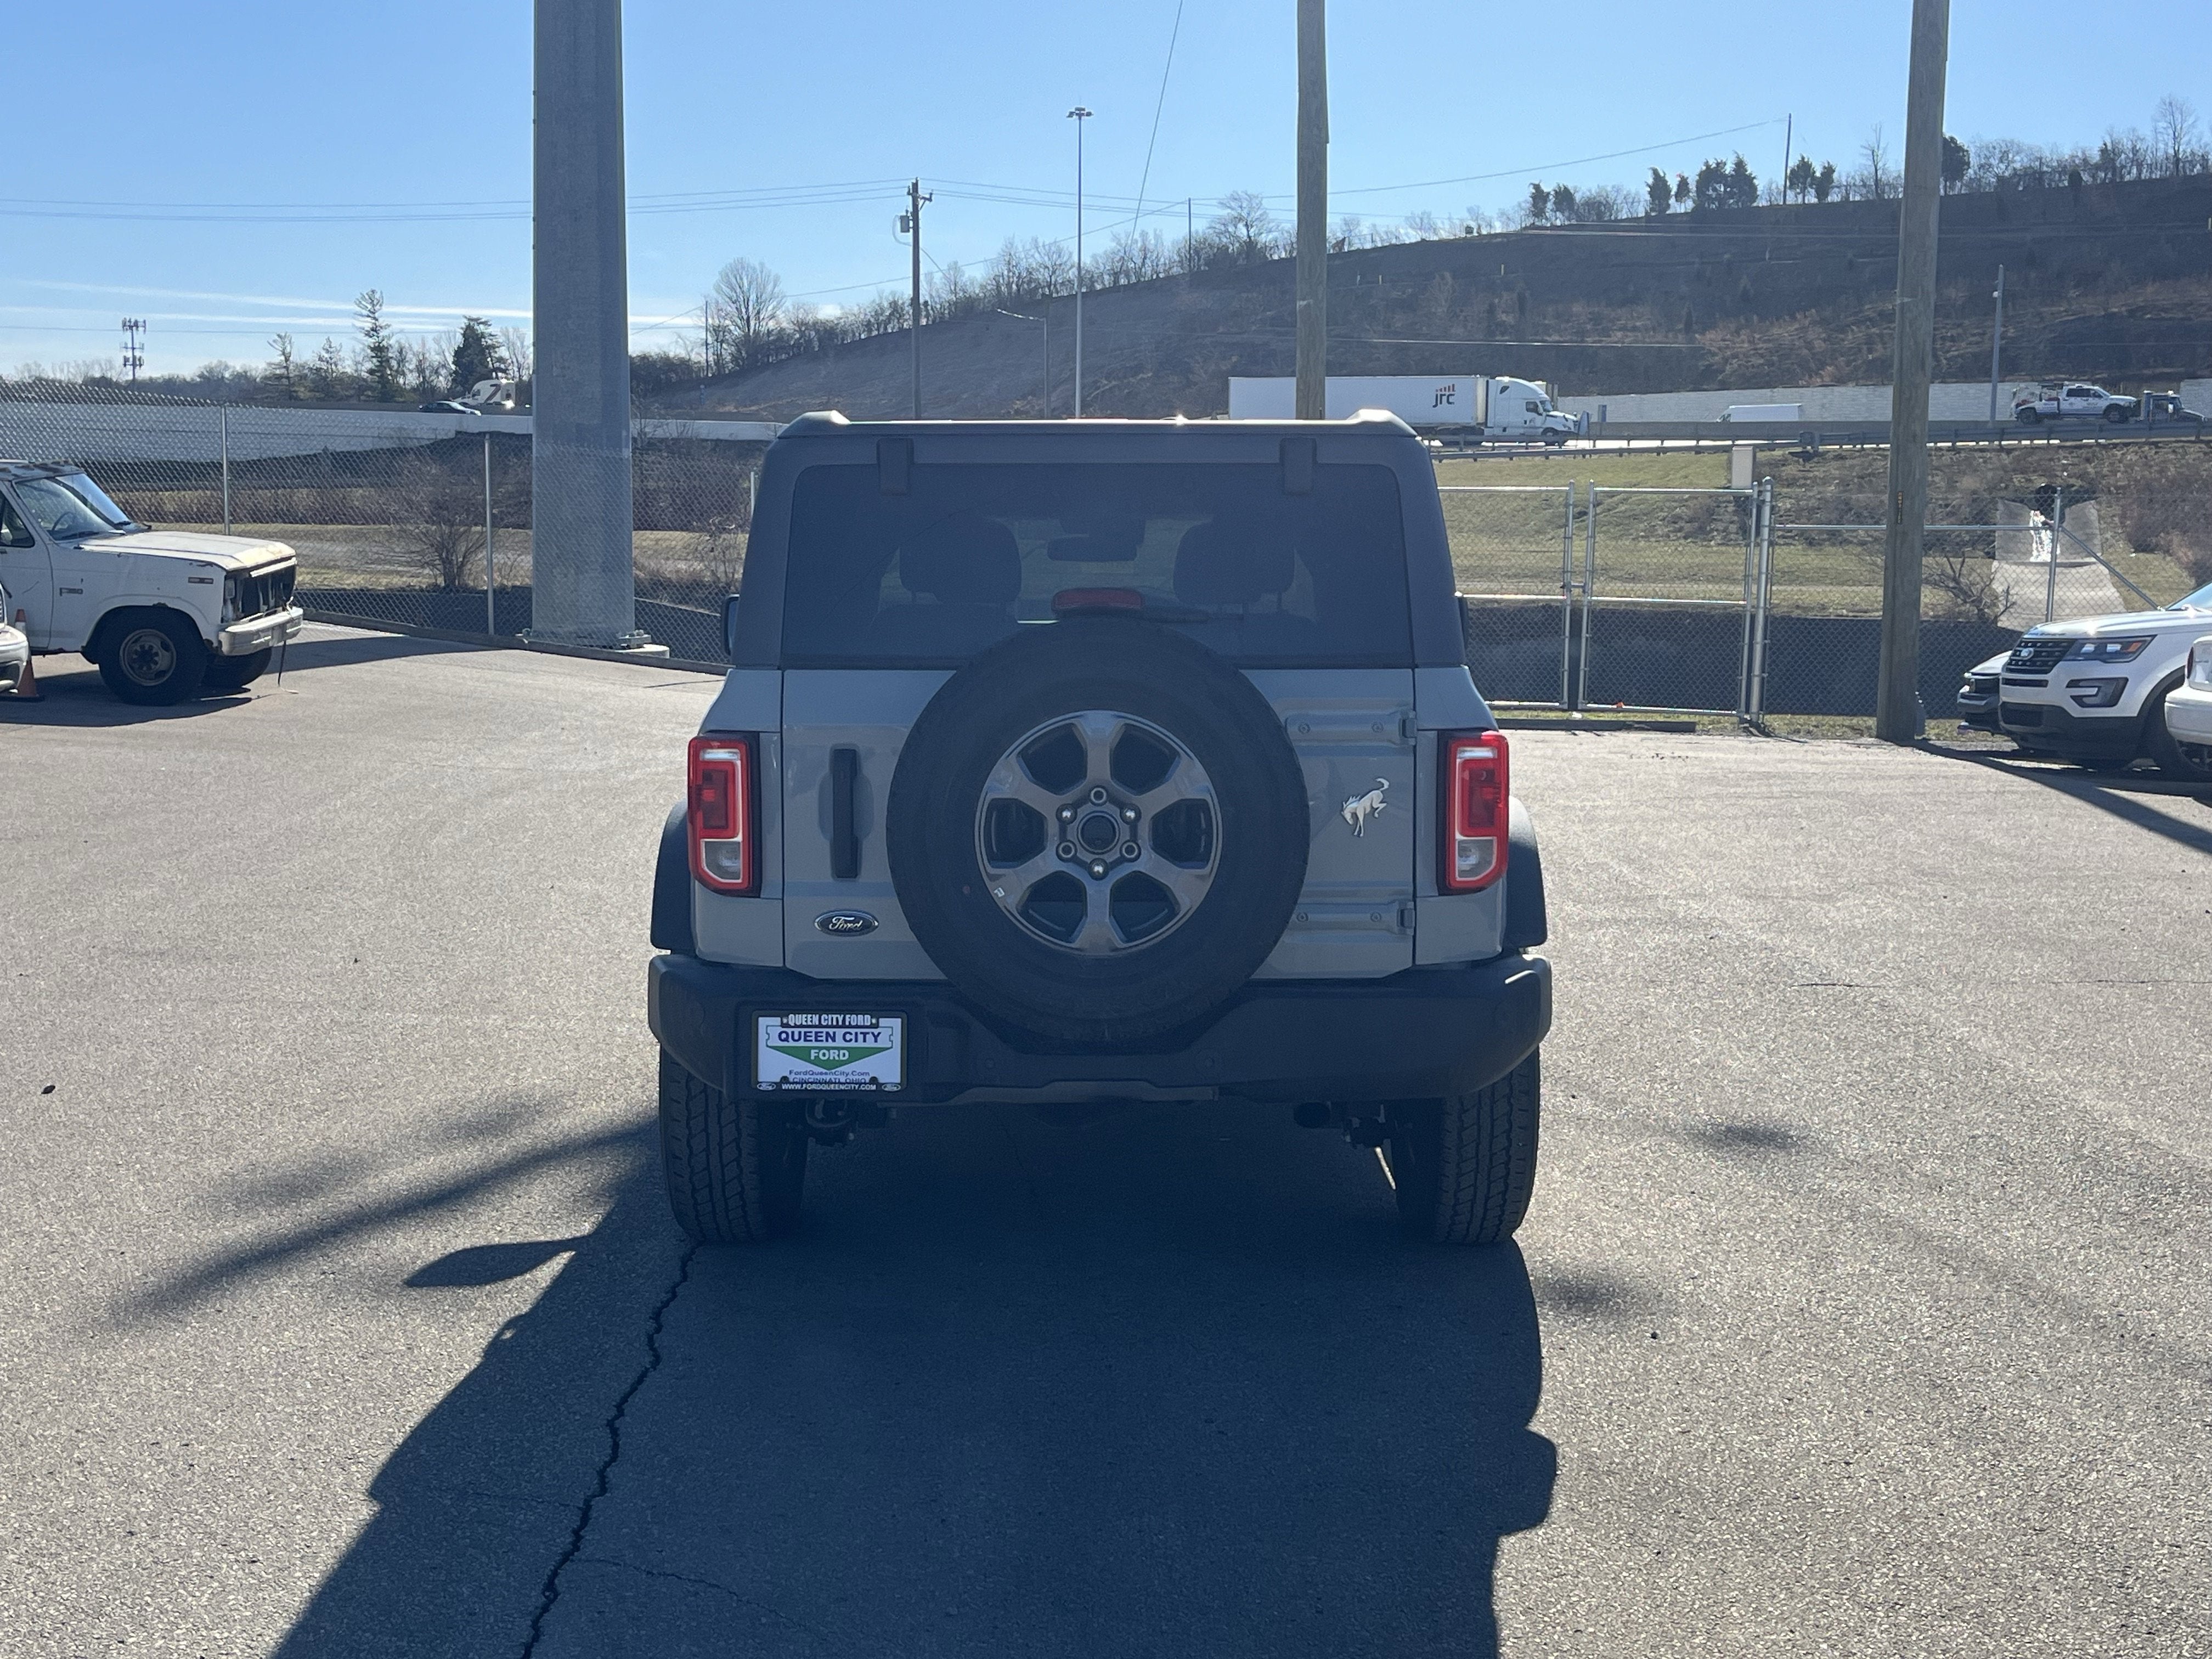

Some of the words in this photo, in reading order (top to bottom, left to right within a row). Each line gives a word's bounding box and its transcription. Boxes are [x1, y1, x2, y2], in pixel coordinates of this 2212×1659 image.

[1432, 390, 1455, 408] jrc
[829, 916, 863, 931] Ford
[788, 1014, 819, 1026] QUEEN
[821, 1014, 844, 1026] CITY
[845, 1015, 871, 1026] FORD
[778, 1031, 836, 1043] QUEEN
[842, 1031, 882, 1043] CITY
[810, 1049, 849, 1060] FORD
